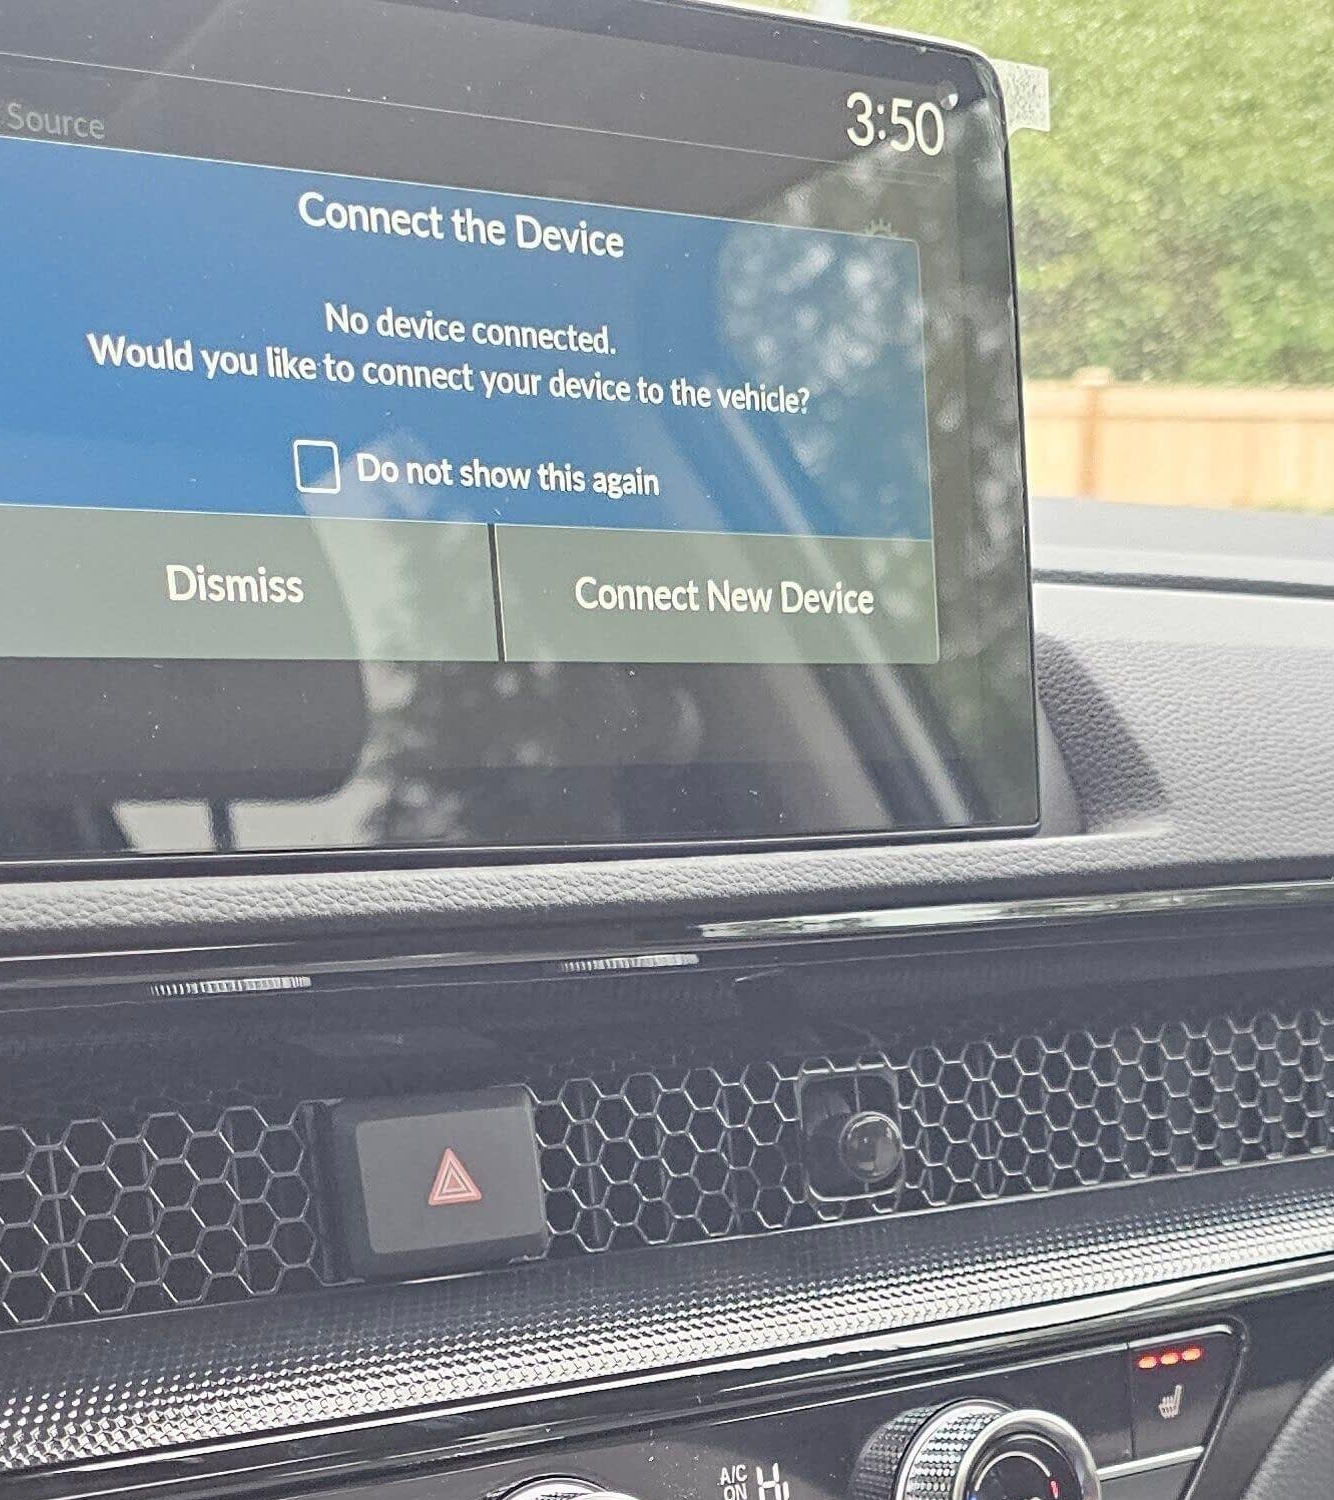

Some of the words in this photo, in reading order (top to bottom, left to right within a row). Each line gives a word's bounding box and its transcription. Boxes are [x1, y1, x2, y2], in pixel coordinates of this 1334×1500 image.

[6, 103, 106, 139] Source
[846, 92, 944, 156] 3:50
[297, 191, 444, 240] Connect
[451, 207, 507, 246] the
[516, 216, 625, 258] Device
[324, 302, 369, 337] No
[376, 307, 465, 344] device
[472, 319, 617, 354] connected.
[87, 332, 194, 371] Would
[202, 349, 258, 379] you
[267, 348, 317, 382] like
[323, 354, 355, 383] to
[362, 359, 473, 393] connect
[480, 371, 542, 401] your
[549, 371, 632, 403] device
[637, 378, 664, 405] to
[671, 378, 711, 408] the
[716, 383, 810, 415] vehicle?
[356, 453, 398, 485] Do
[407, 457, 454, 488] not
[459, 458, 531, 493] show
[538, 461, 586, 493] this
[593, 465, 660, 500] again
[167, 563, 304, 606] Dismiss
[574, 576, 699, 613] Connect
[707, 579, 773, 614] New
[780, 580, 875, 615] Device
[719, 1464, 748, 1487] A/C
